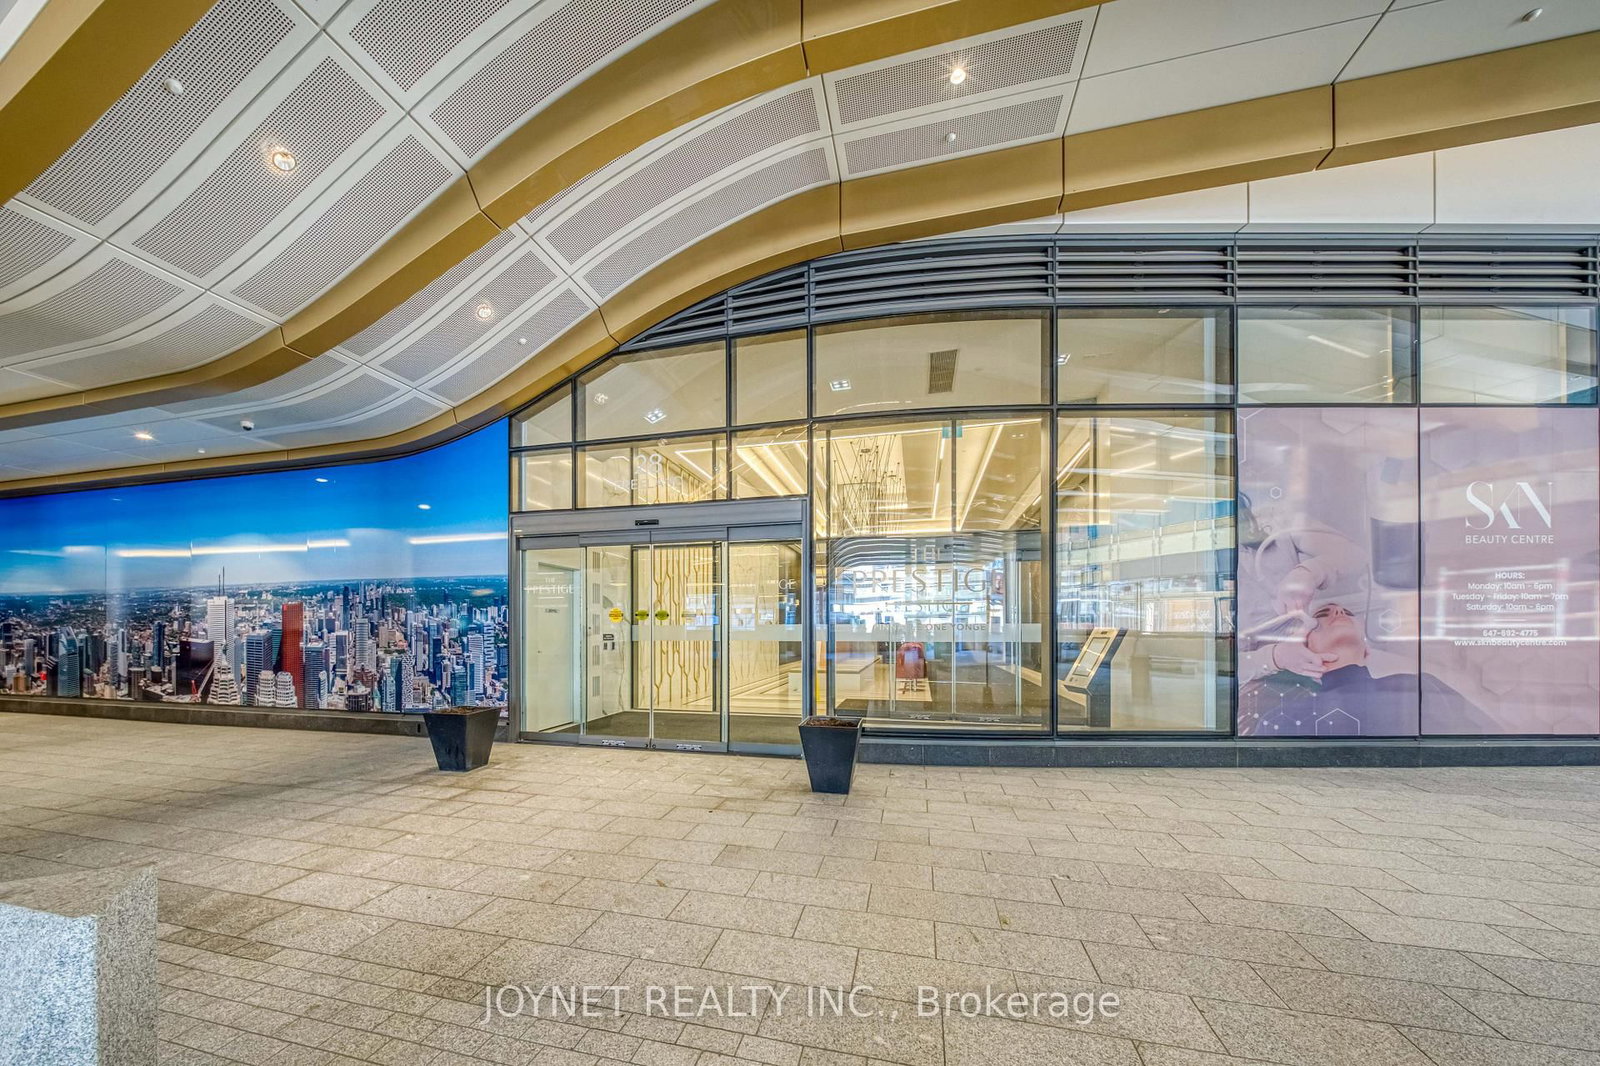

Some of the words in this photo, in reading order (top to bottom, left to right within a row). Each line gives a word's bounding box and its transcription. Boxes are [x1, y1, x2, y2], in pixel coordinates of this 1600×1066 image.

[1465, 534, 1507, 544] BEAUTY
[1511, 534, 1554, 544] CENTRE
[1495, 572, 1525, 580] HOURS:
[1467, 582, 1502, 591] Monday:
[1504, 582, 1525, 590] 10am
[1533, 582, 1553, 591] 6pm
[1452, 592, 1485, 601] Tuesday
[1466, 603, 1504, 612] Saturday:
[1505, 603, 1527, 611] 10am
[1535, 603, 1555, 612] 6pm
